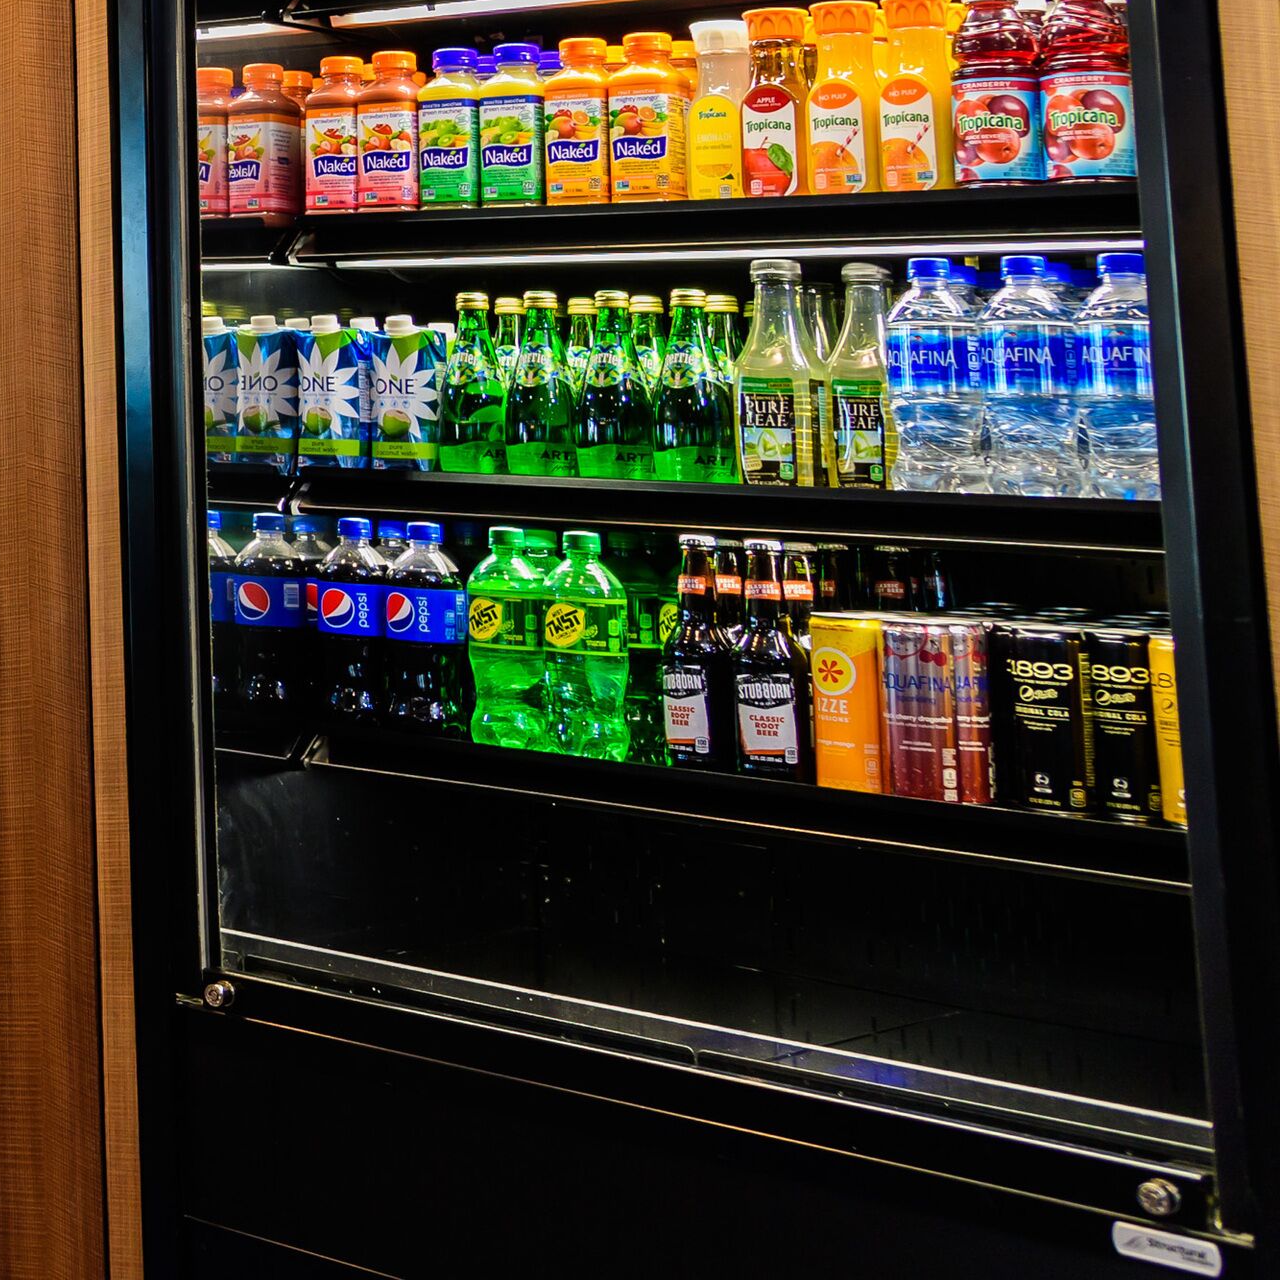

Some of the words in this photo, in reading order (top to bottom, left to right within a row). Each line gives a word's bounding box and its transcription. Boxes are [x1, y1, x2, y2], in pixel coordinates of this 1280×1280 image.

[962, 81, 1011, 89] CRANBERRY
[1054, 76, 1105, 84] CRANBERRY
[819, 94, 830, 102] NO
[812, 114, 859, 130] Tropicana
[883, 111, 929, 124] Tropicana
[958, 113, 1023, 135] Tropicana
[1050, 108, 1117, 131] Tropicana
[746, 121, 791, 132] Tropicana
[887, 346, 958, 369] AQUAFINA
[982, 345, 1055, 368] AQUAFINA
[302, 375, 336, 392] ONE
[376, 378, 414, 395] ONE
[746, 400, 789, 414] PURE
[746, 414, 786, 427] LEAF
[541, 449, 572, 460] ART
[694, 453, 728, 466] ART
[356, 592, 369, 628] pepsi
[418, 597, 431, 633] pepsi
[739, 681, 791, 700] STUBBORN
[817, 697, 849, 714] IZZE
[749, 715, 785, 723] CLASSIC
